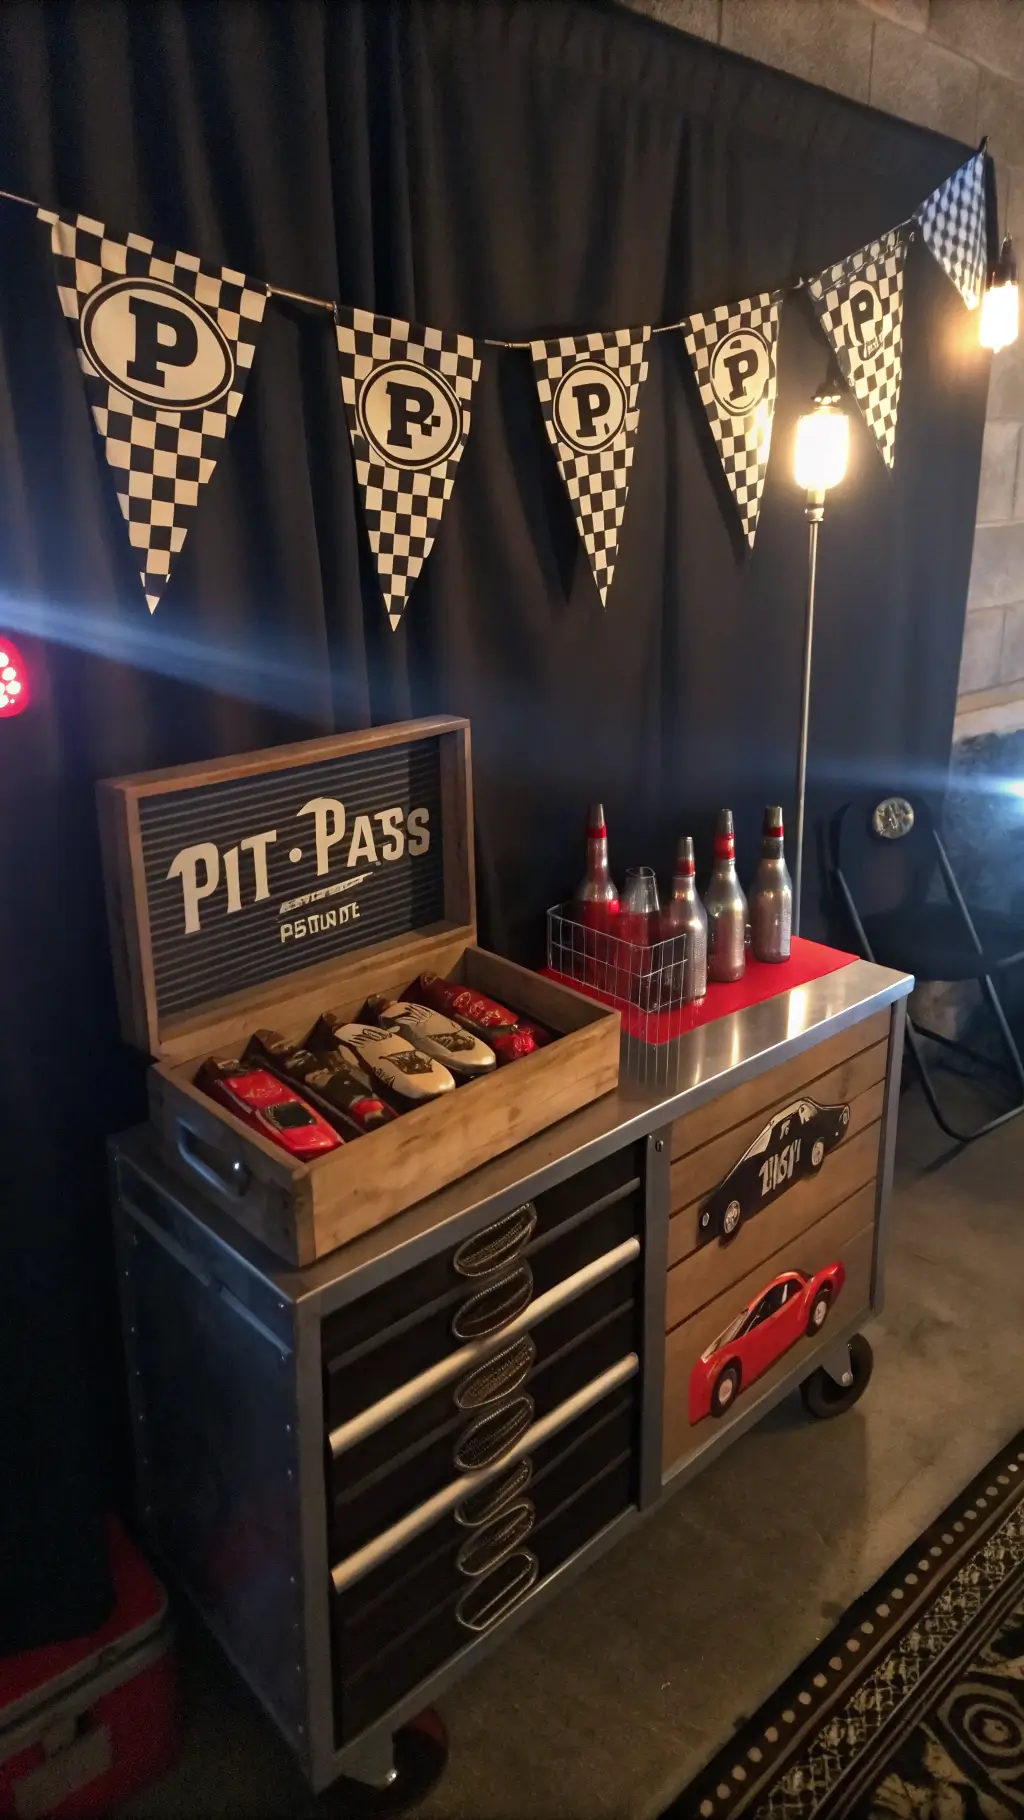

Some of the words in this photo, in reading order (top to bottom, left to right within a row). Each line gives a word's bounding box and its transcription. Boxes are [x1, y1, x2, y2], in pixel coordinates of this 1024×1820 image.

[126, 296, 198, 387] P
[850, 289, 874, 344] P
[724, 348, 759, 400] P
[572, 383, 611, 437] P
[166, 830, 277, 934] PIT
[296, 797, 431, 876] PASS
